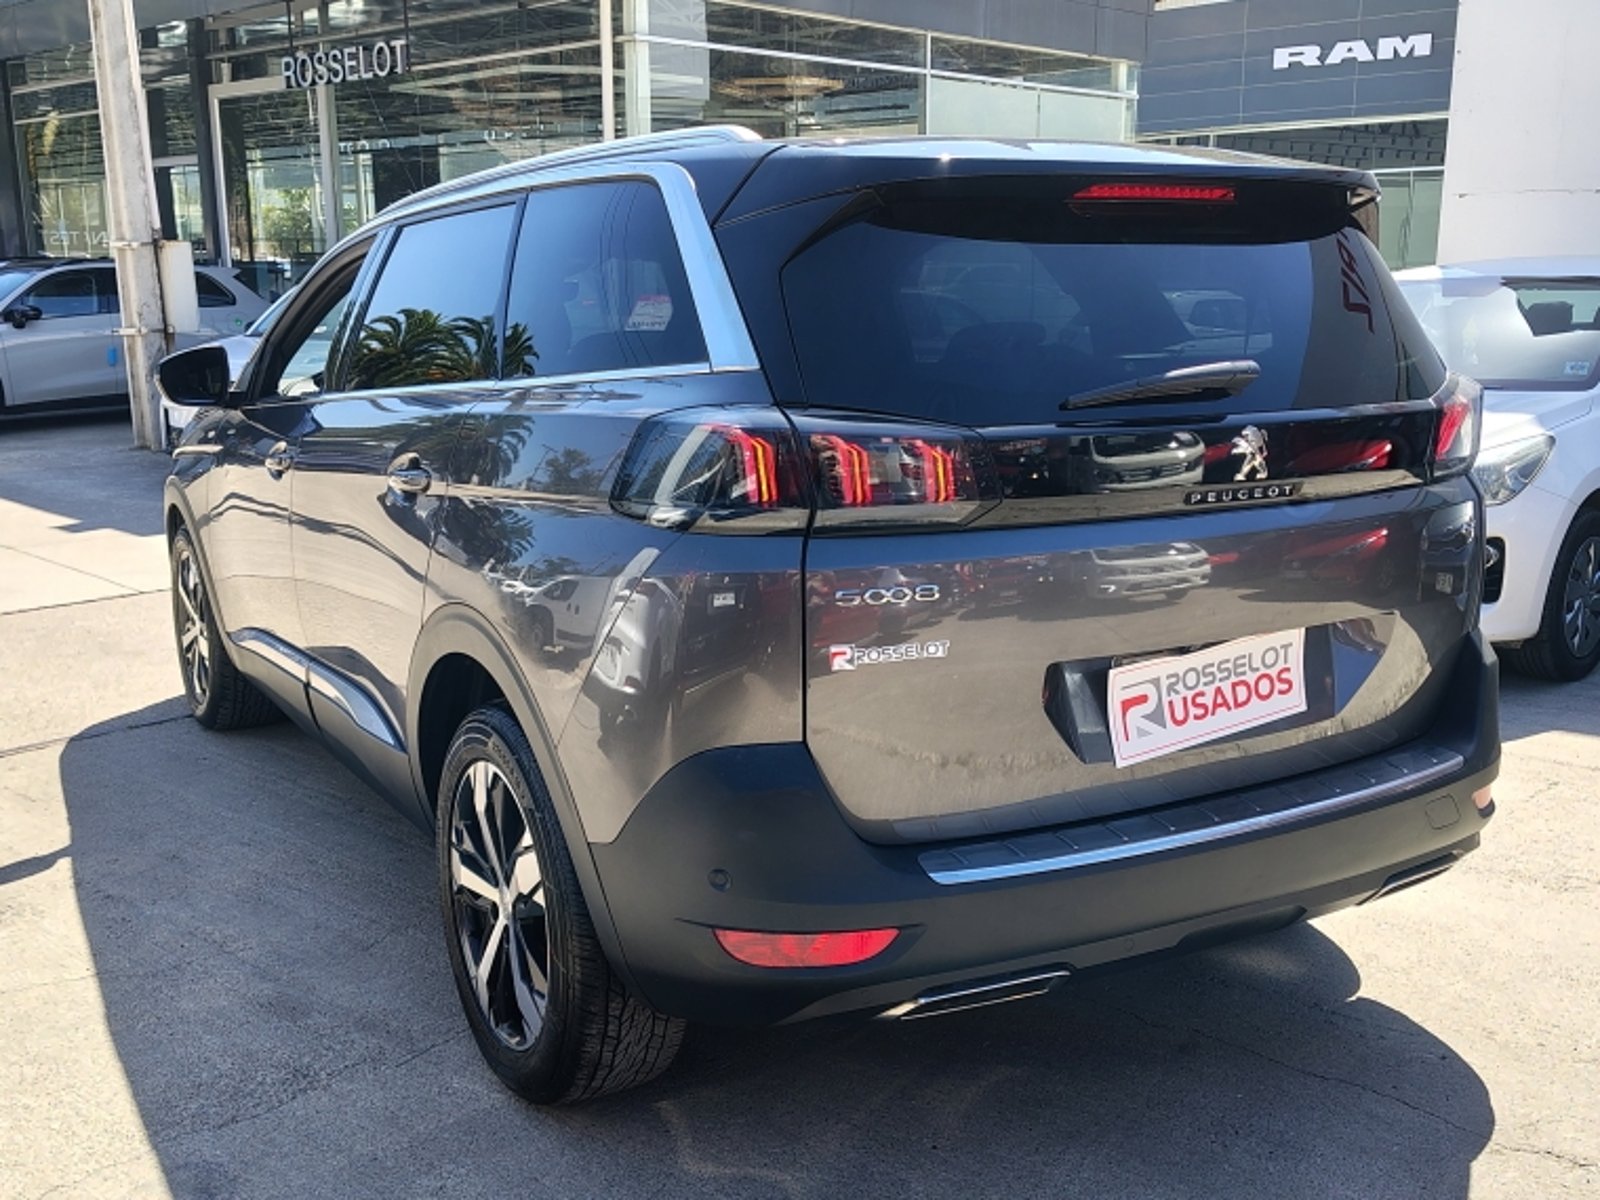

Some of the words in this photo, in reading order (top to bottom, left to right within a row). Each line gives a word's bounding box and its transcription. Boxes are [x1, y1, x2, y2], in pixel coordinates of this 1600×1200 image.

[281, 39, 406, 88] ROSSELOT
[1273, 33, 1432, 70] RAM
[1190, 485, 1293, 504] PEUGEOT
[835, 584, 940, 606] 5008
[856, 641, 949, 663] ROSSELOT
[1166, 643, 1293, 697] ROSSELOT
[1168, 667, 1293, 727] USADOS
